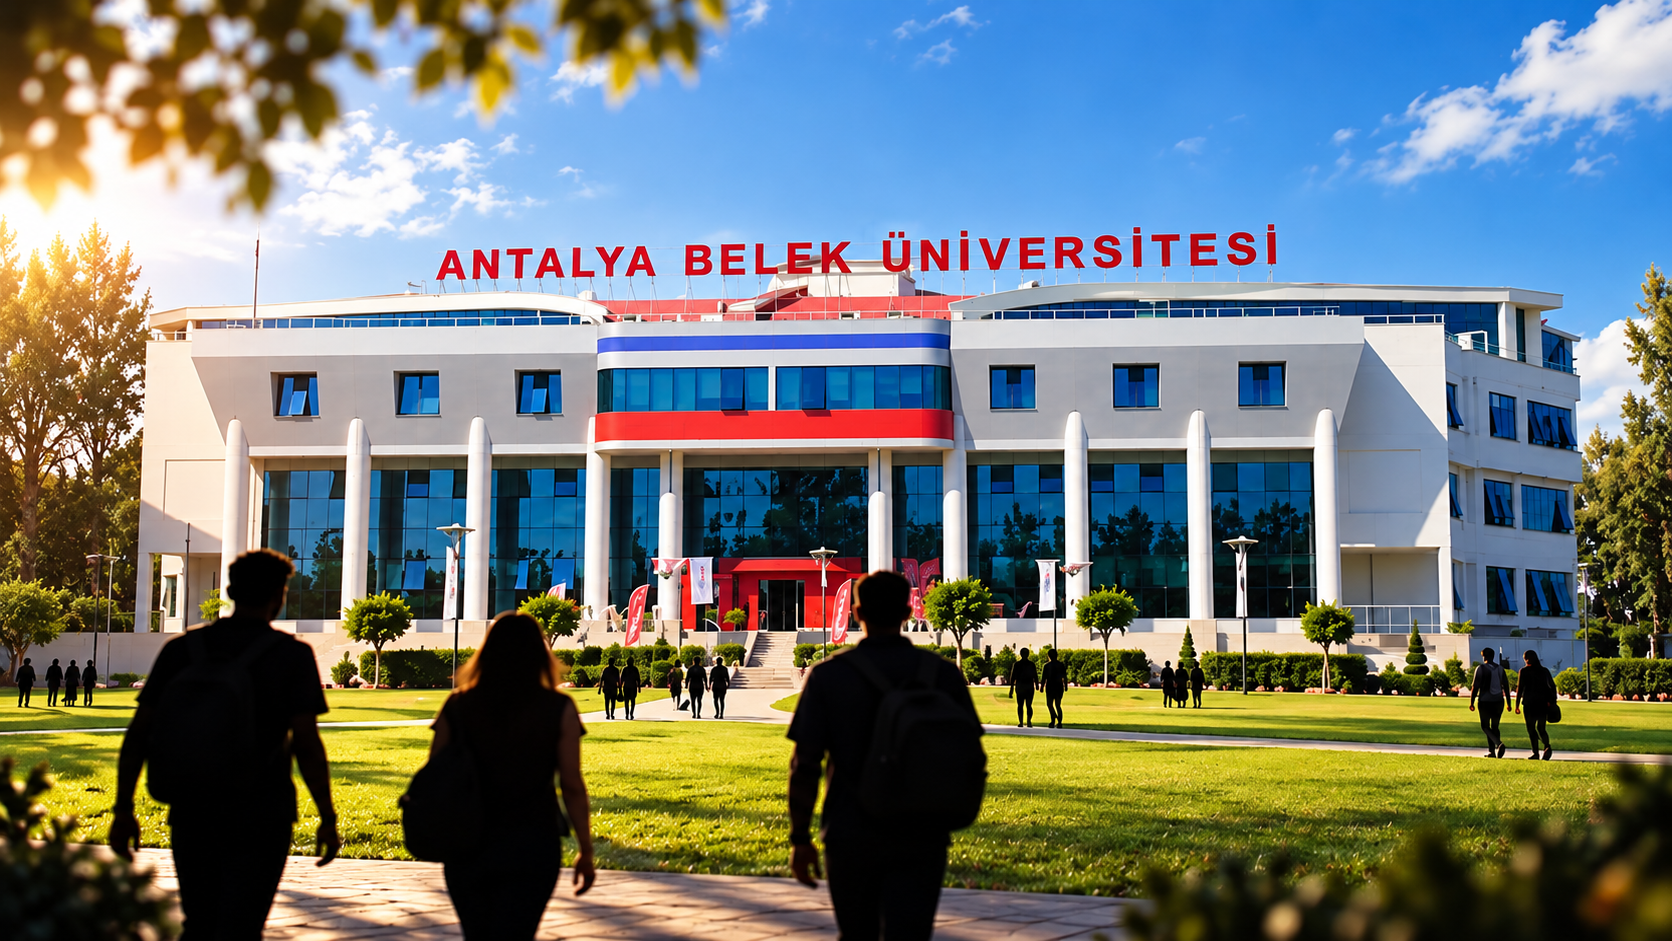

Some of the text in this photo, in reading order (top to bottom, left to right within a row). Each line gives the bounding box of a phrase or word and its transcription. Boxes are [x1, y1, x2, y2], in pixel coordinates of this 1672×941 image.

[437, 224, 1277, 280] ANTALYA BELEK ÜNİVERSİTESİ
